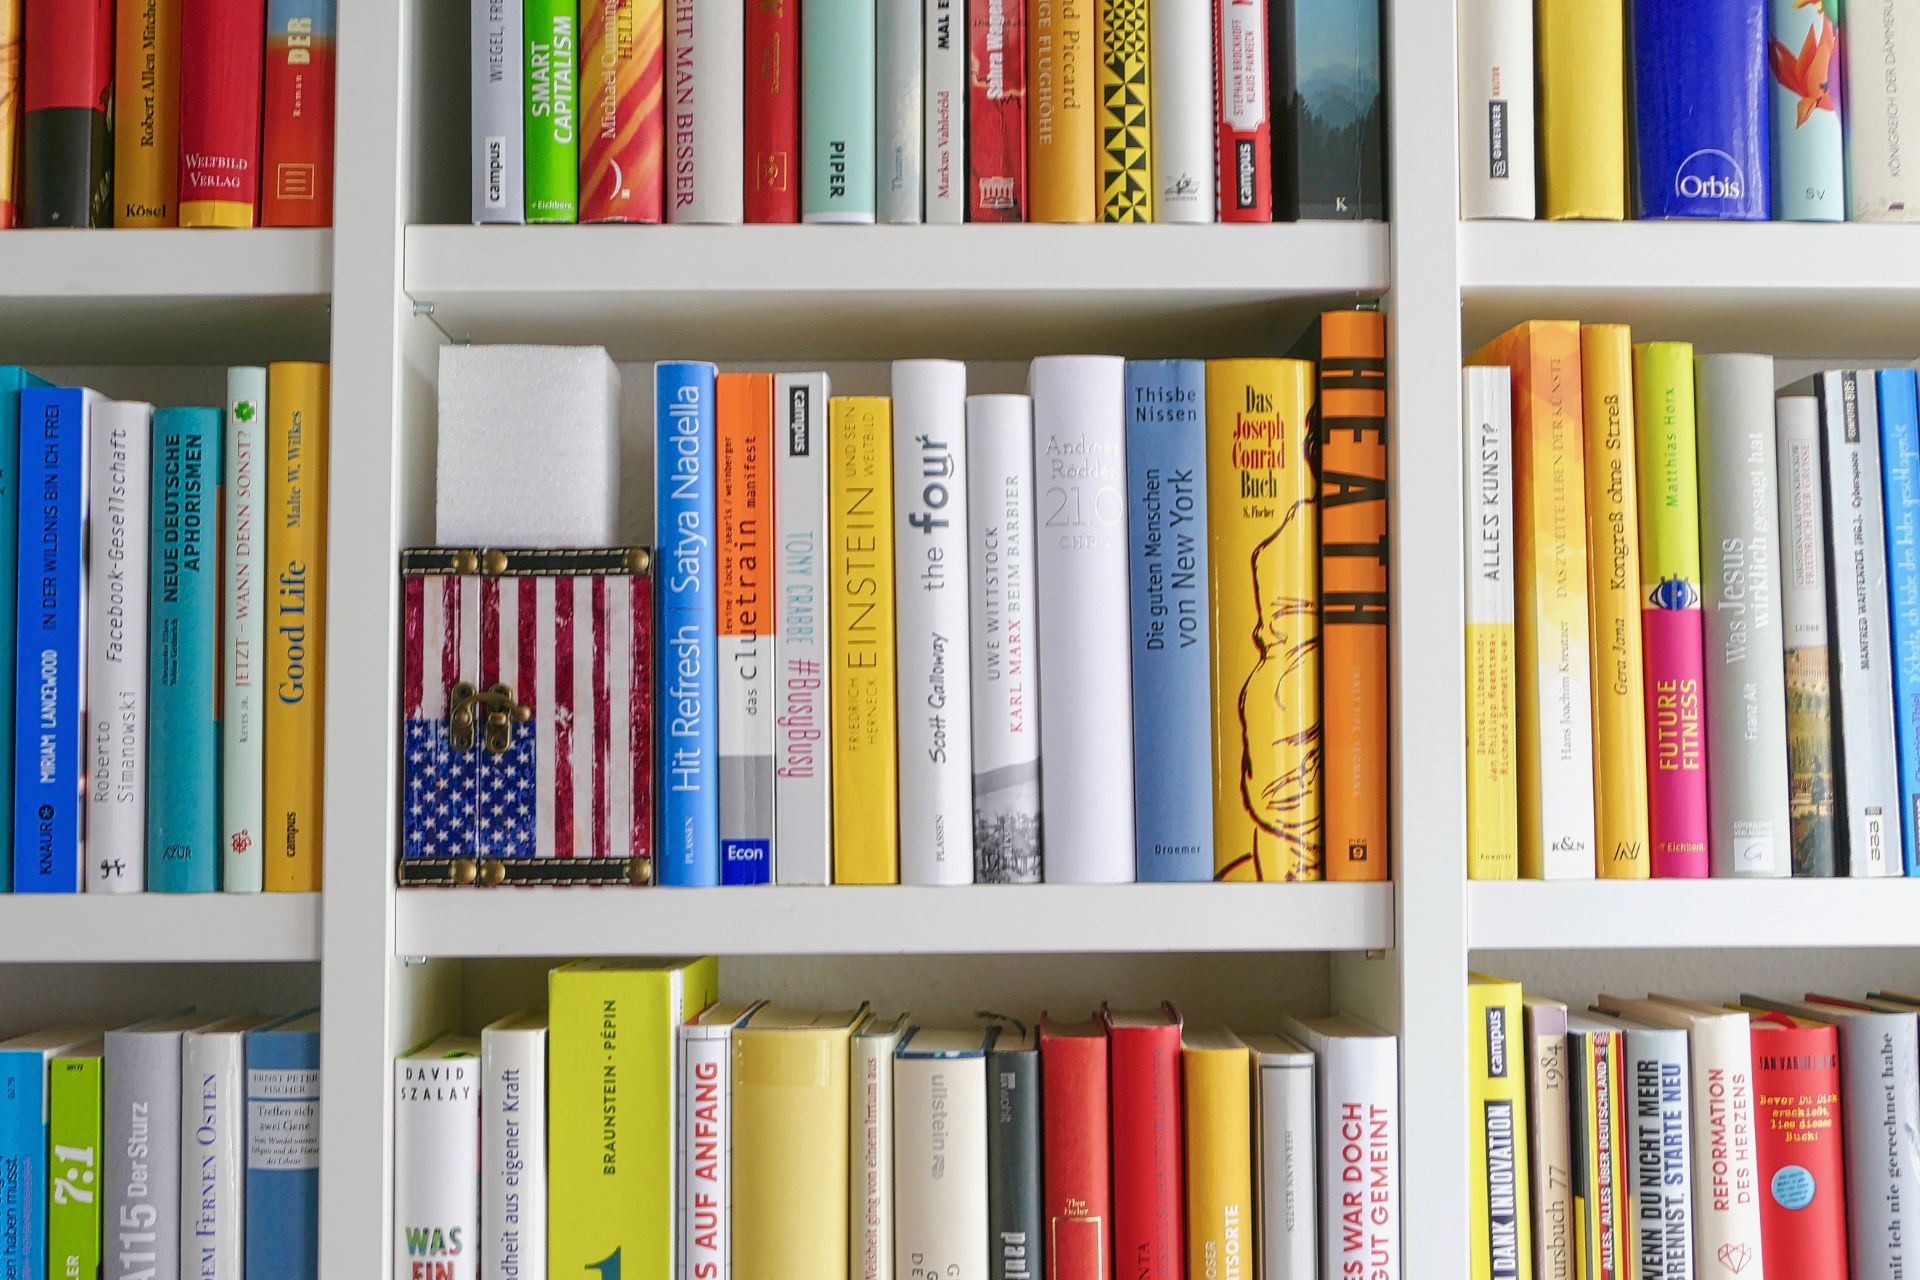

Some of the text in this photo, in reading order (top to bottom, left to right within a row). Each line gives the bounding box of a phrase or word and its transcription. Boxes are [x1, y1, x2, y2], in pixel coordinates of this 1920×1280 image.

[141, 54, 155, 147] Robert Allen
[287, 18, 311, 117] Roman DER
[531, 41, 551, 117] SMART
[553, 15, 573, 144] CAPITALISM
[601, 70, 617, 140] Michael
[937, 15, 950, 199] Markus MAL
[986, 52, 1003, 99] Sahra
[1038, 35, 1054, 145] FLUGHÖHE
[1062, 30, 1080, 109] Piccard
[1233, 74, 1244, 116] STEPHAN
[1885, 69, 1898, 93] DER
[186, 153, 247, 170] WELTBILD
[190, 172, 240, 188] VERLAG
[488, 142, 503, 202] campus
[676, 46, 694, 209] MAN BESSER
[830, 141, 845, 198] PIPER
[1240, 143, 1254, 206] campus
[1492, 104, 1502, 160] GMEINER
[127, 204, 166, 218] Kösel
[1336, 197, 1348, 211] K
[1680, 175, 1740, 198] Orbis
[287, 410, 302, 483] W. Wilkes
[790, 390, 806, 452] campus
[1135, 387, 1196, 403] Thisbe
[1136, 407, 1197, 422] Nissen
[1233, 412, 1285, 447] Joseph
[1246, 384, 1272, 413] Das
[164, 434, 180, 544] DEUTSCHE
[184, 434, 201, 573] APHORISMEN
[1232, 440, 1285, 469] Conrad
[1241, 470, 1277, 499] Buch
[1320, 357, 1386, 624] HEATH
[1482, 422, 1500, 581] ALLES KUNST?
[42, 404, 60, 631] IN DER WILDNIS BIN ICH FREI
[106, 429, 126, 663] Facebook-Gesellschaft
[235, 430, 251, 687] JETZT WANN DENN SONST?
[723, 436, 734, 635] levine locke searls weinberger
[1142, 468, 1167, 650] Die guten Menschen
[1167, 469, 1197, 649] von New York
[1604, 394, 1628, 696] Gera Kongreß ohne Streß
[1747, 432, 1769, 629] wirklich gesagt hat
[163, 548, 178, 604] NEUE
[669, 385, 707, 865] PLASSEN Hit Refresh Satya Nadella
[734, 436, 757, 716] das cluetrain manifest
[785, 531, 813, 644] TONY CRABBE
[846, 487, 877, 668] EINSTEIN
[909, 434, 953, 764] Scott Galloway the four
[985, 526, 1000, 681] UWE WITTSTOCK
[1005, 474, 1022, 734] KARL MARX BEIM BARBIER
[1657, 387, 1679, 770] FUTURE Matthias Horx
[1718, 537, 1759, 740] Franz Was Jesus
[39, 649, 57, 875] KNAUR MIRIAM LANCEWOOD
[94, 721, 110, 803] Roberto
[117, 691, 135, 802] Simanowski
[278, 560, 305, 858] campus Good Life
[777, 658, 820, 778] #BusyBusy
[1680, 679, 1699, 770] FITNESS
[728, 845, 763, 861] Econ
[195, 1074, 216, 1147] OSTEN
[401, 1086, 470, 1101] SZALAY
[405, 1067, 464, 1080] DAVID
[600, 1000, 616, 1176] BRAUNSTEIN PÉPIN
[931, 1073, 948, 1150] ullstein
[1541, 1043, 1566, 1190] 77 1984
[1595, 1062, 1609, 1149] DEUTSCHLAND
[1661, 1063, 1683, 1186] STARTE NEU
[54, 1145, 94, 1206] 7:1
[127, 1103, 148, 1199] Der Sturz
[502, 1068, 523, 1224] aus eigener Kraft
[694, 1062, 717, 1250] AUF ANFANG
[865, 1057, 879, 1225] ging von einem aus
[1342, 1103, 1363, 1253] WAR DOCH
[1370, 1104, 1388, 1226] GEMEINT
[1487, 1011, 1516, 1271] DANK INNOVATION campus
[1597, 1152, 1611, 1184] ÜBER
[1637, 1059, 1662, 1219] DU NICHT MEHR
[1708, 1069, 1729, 1212] REFORMATION
[1732, 1074, 1751, 1204] DES HERZENS
[1880, 1033, 1901, 1249] ich nie gerechnet habe
[5, 1209, 17, 1256] haben
[405, 1226, 462, 1256] WAS
[1600, 1187, 1612, 1226] ALLES
[1601, 1228, 1614, 1271] ALLES,
